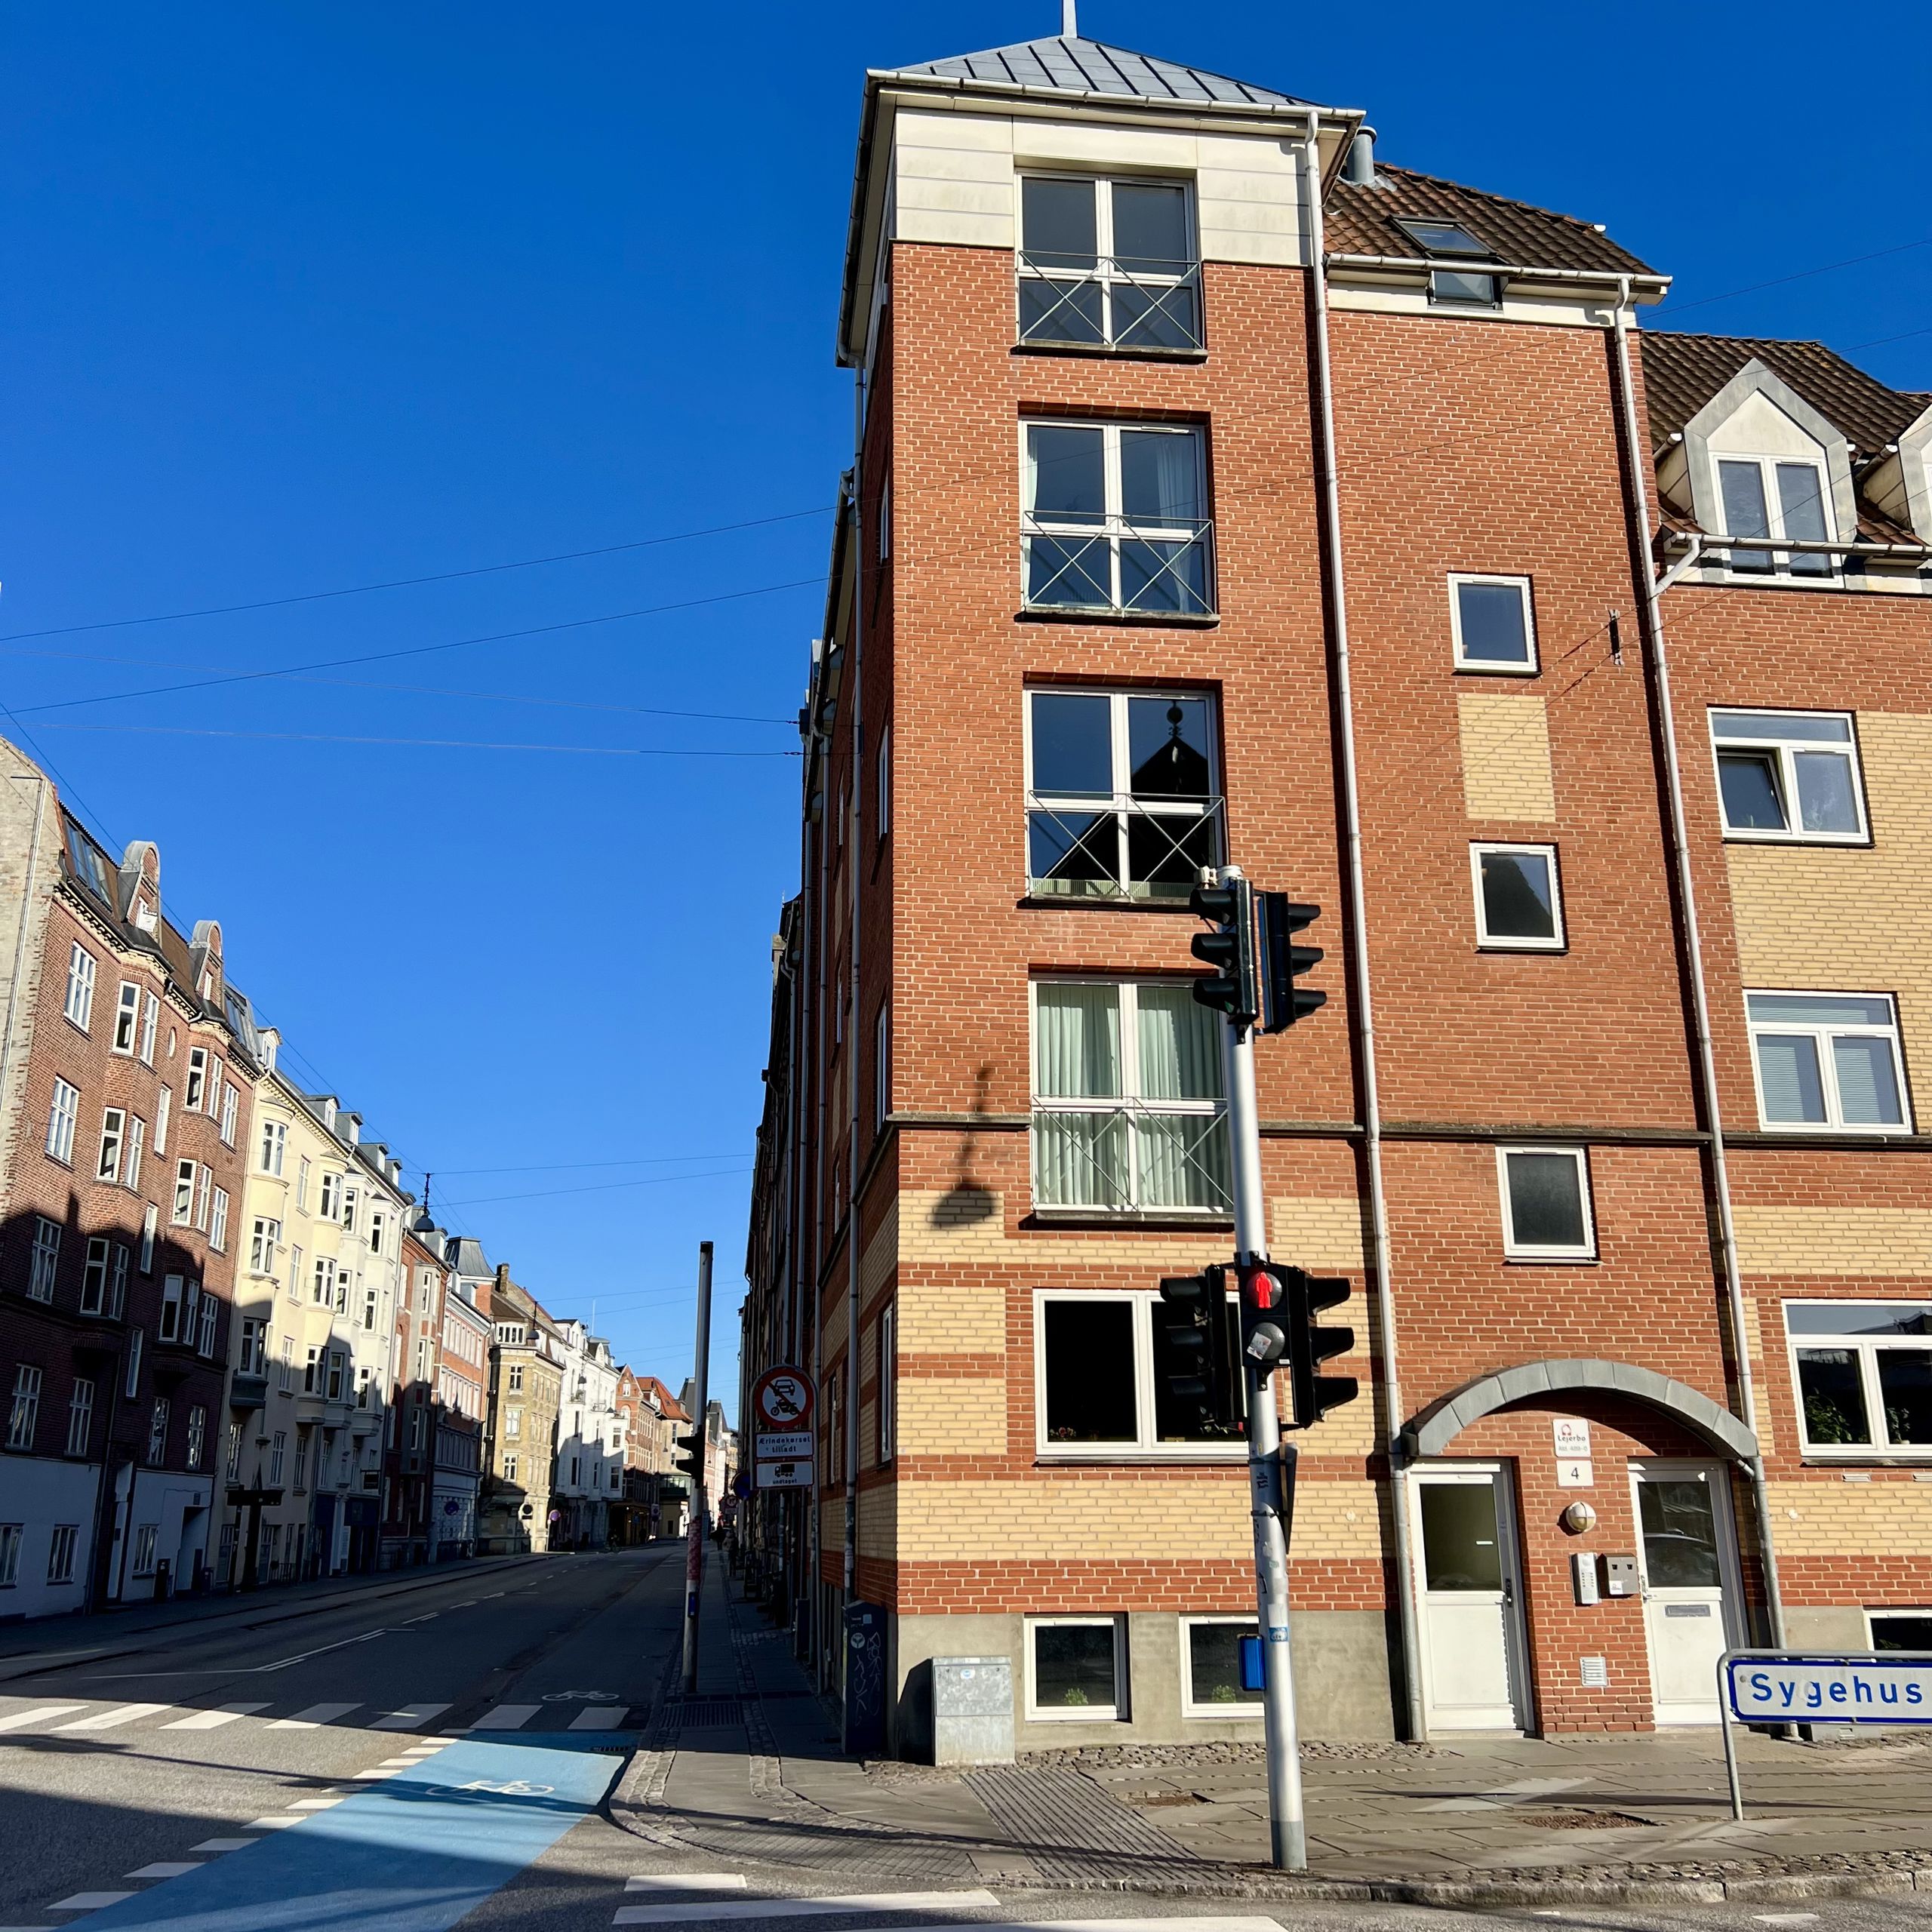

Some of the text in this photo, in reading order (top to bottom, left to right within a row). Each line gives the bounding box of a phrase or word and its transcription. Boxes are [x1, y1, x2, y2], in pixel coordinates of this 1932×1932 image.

[1558, 1435, 1586, 1443] Lejerbo
[1571, 1467, 1579, 1479] 4
[1750, 1673, 1923, 1708] Sygehus
